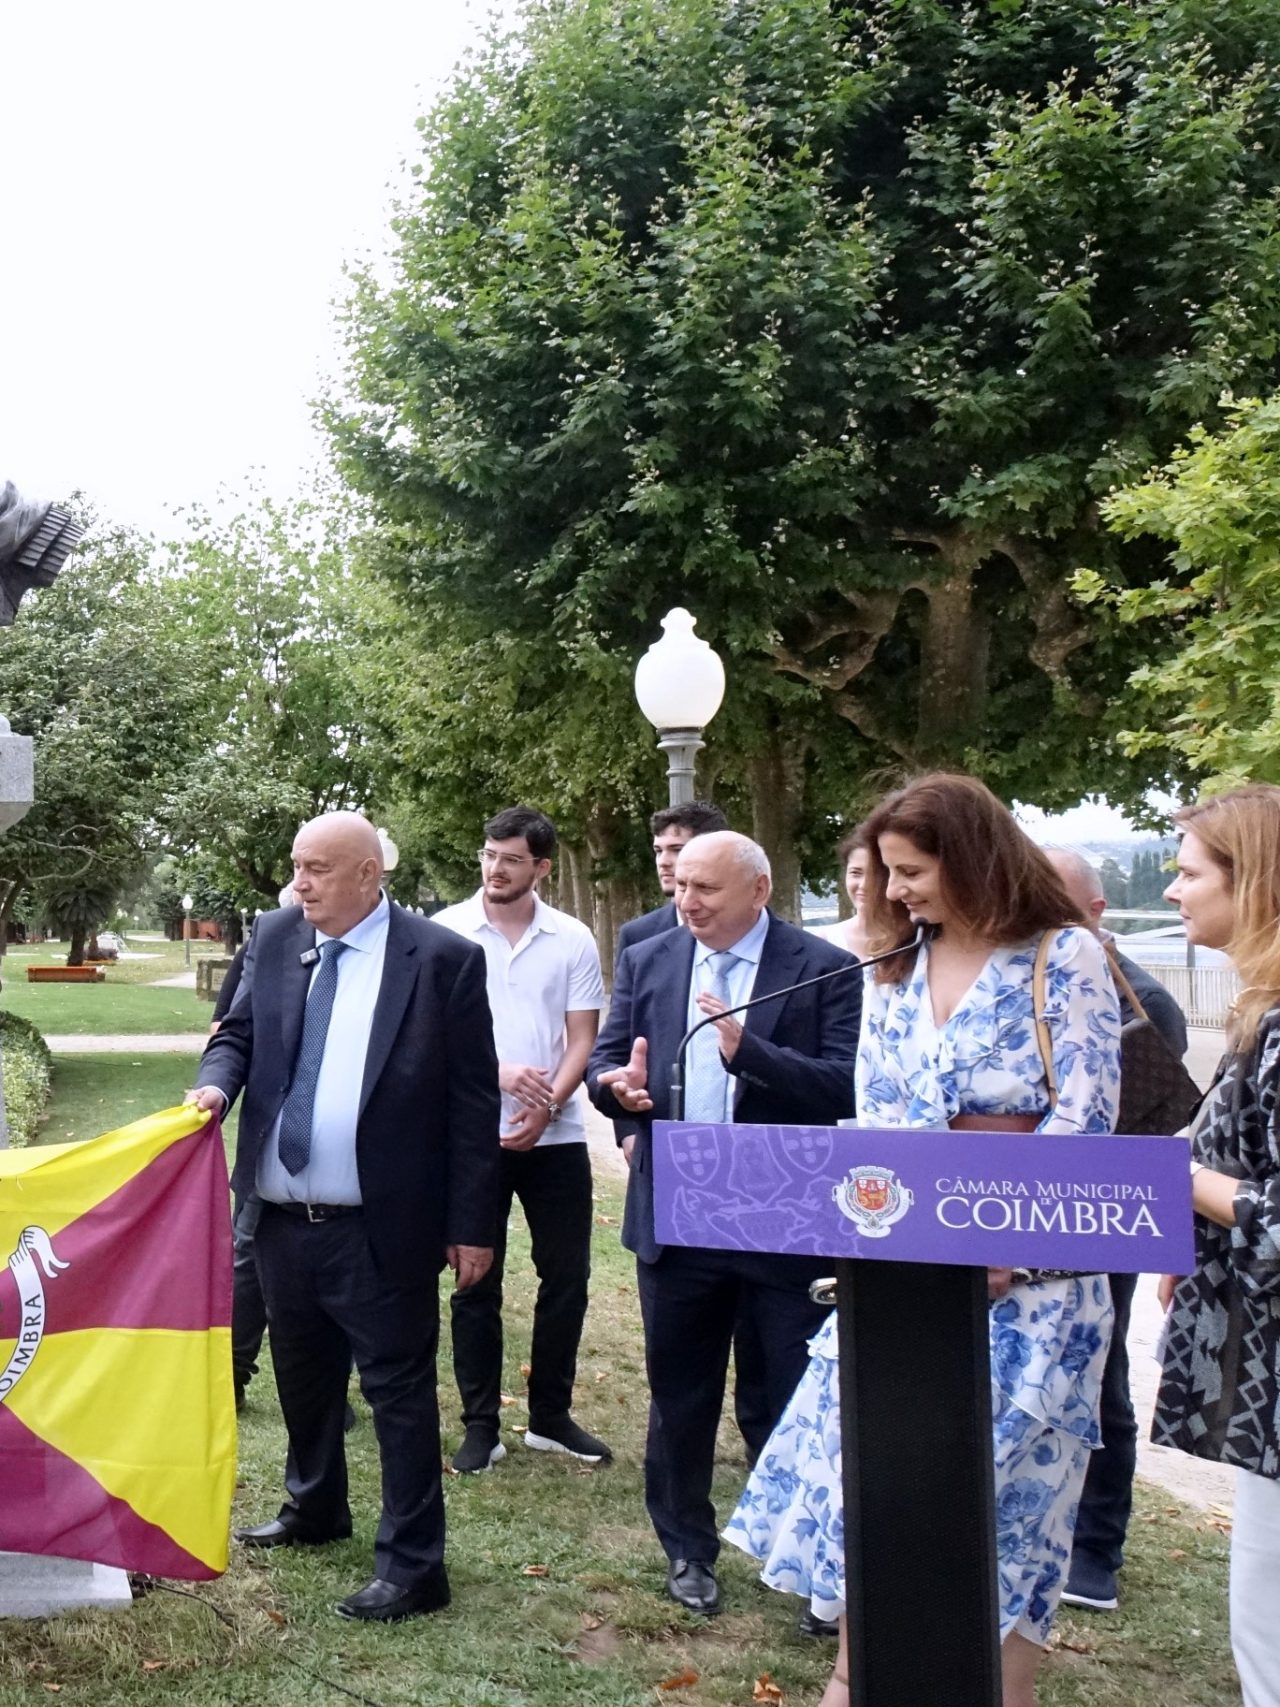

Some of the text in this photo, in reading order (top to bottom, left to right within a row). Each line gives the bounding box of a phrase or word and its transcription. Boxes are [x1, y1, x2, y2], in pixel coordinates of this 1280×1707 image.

[935, 1176, 1159, 1201] CÂMARA MUNICIPAL
[1041, 1198, 1053, 1206] DE
[936, 1196, 1164, 1237] COIMBRA
